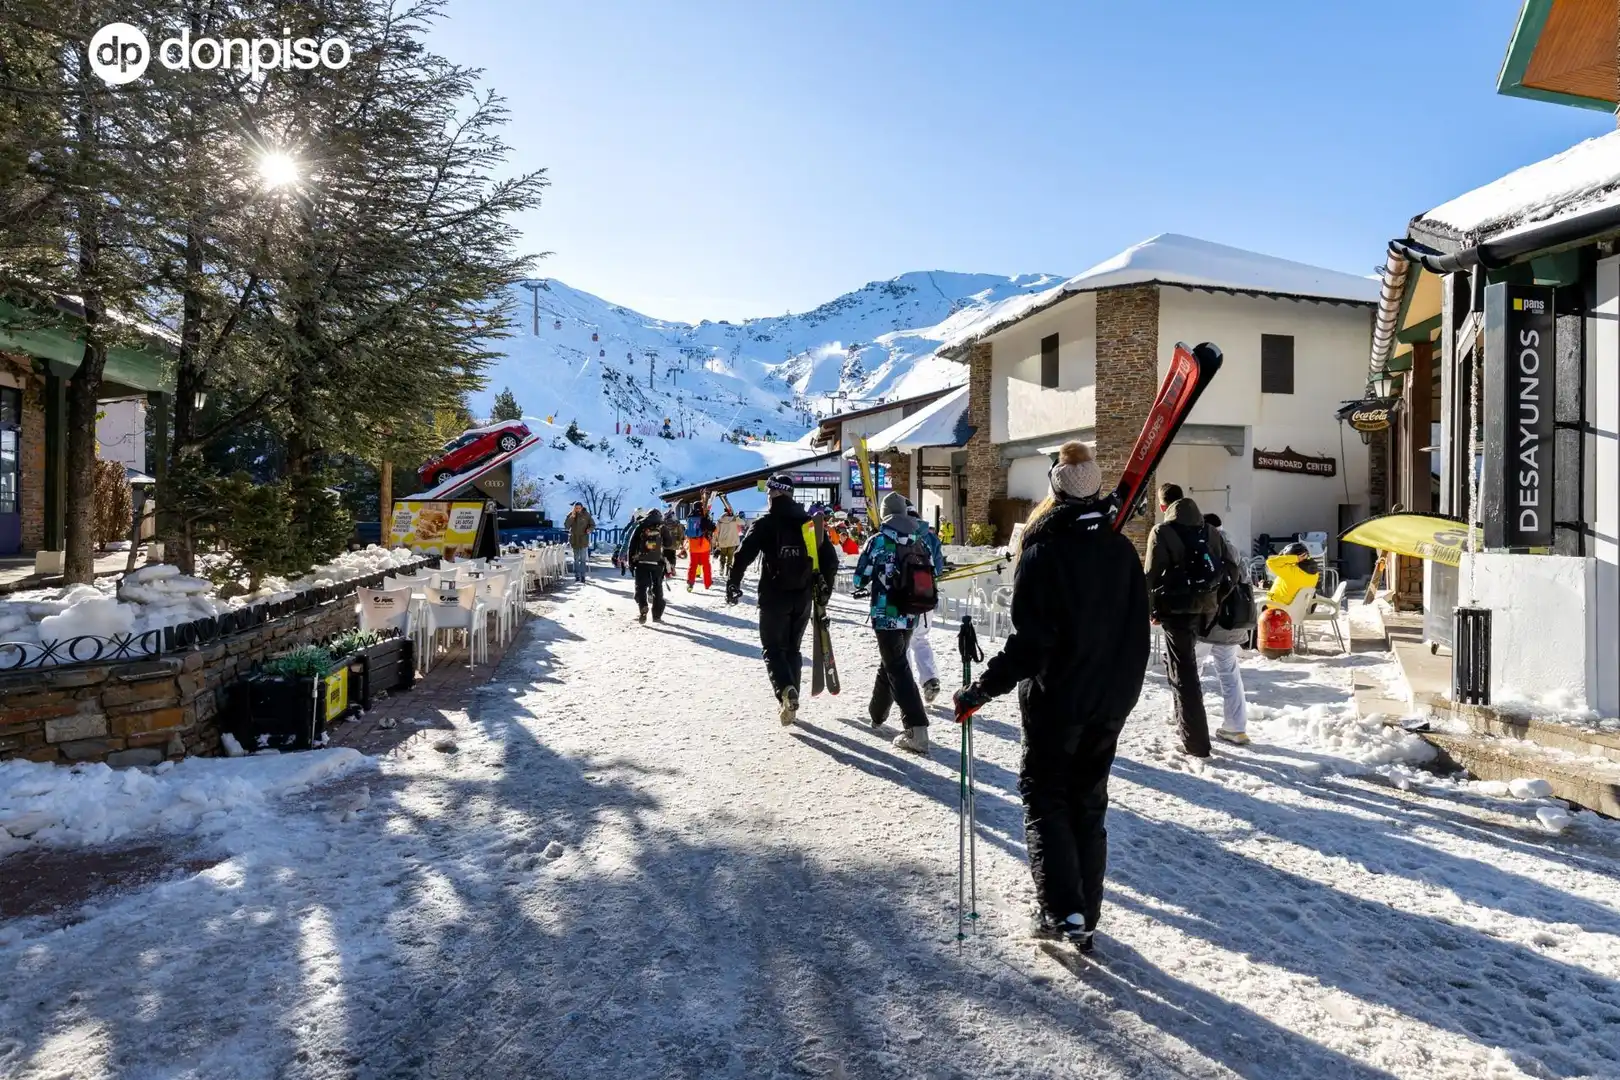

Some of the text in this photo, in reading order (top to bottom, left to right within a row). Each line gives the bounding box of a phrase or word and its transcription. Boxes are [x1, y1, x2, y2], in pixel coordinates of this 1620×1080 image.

[1523, 299, 1545, 311] pans
[1519, 329, 1540, 532] DESAYUNOS
[1258, 457, 1333, 472] SNOWBOARD CENTER
